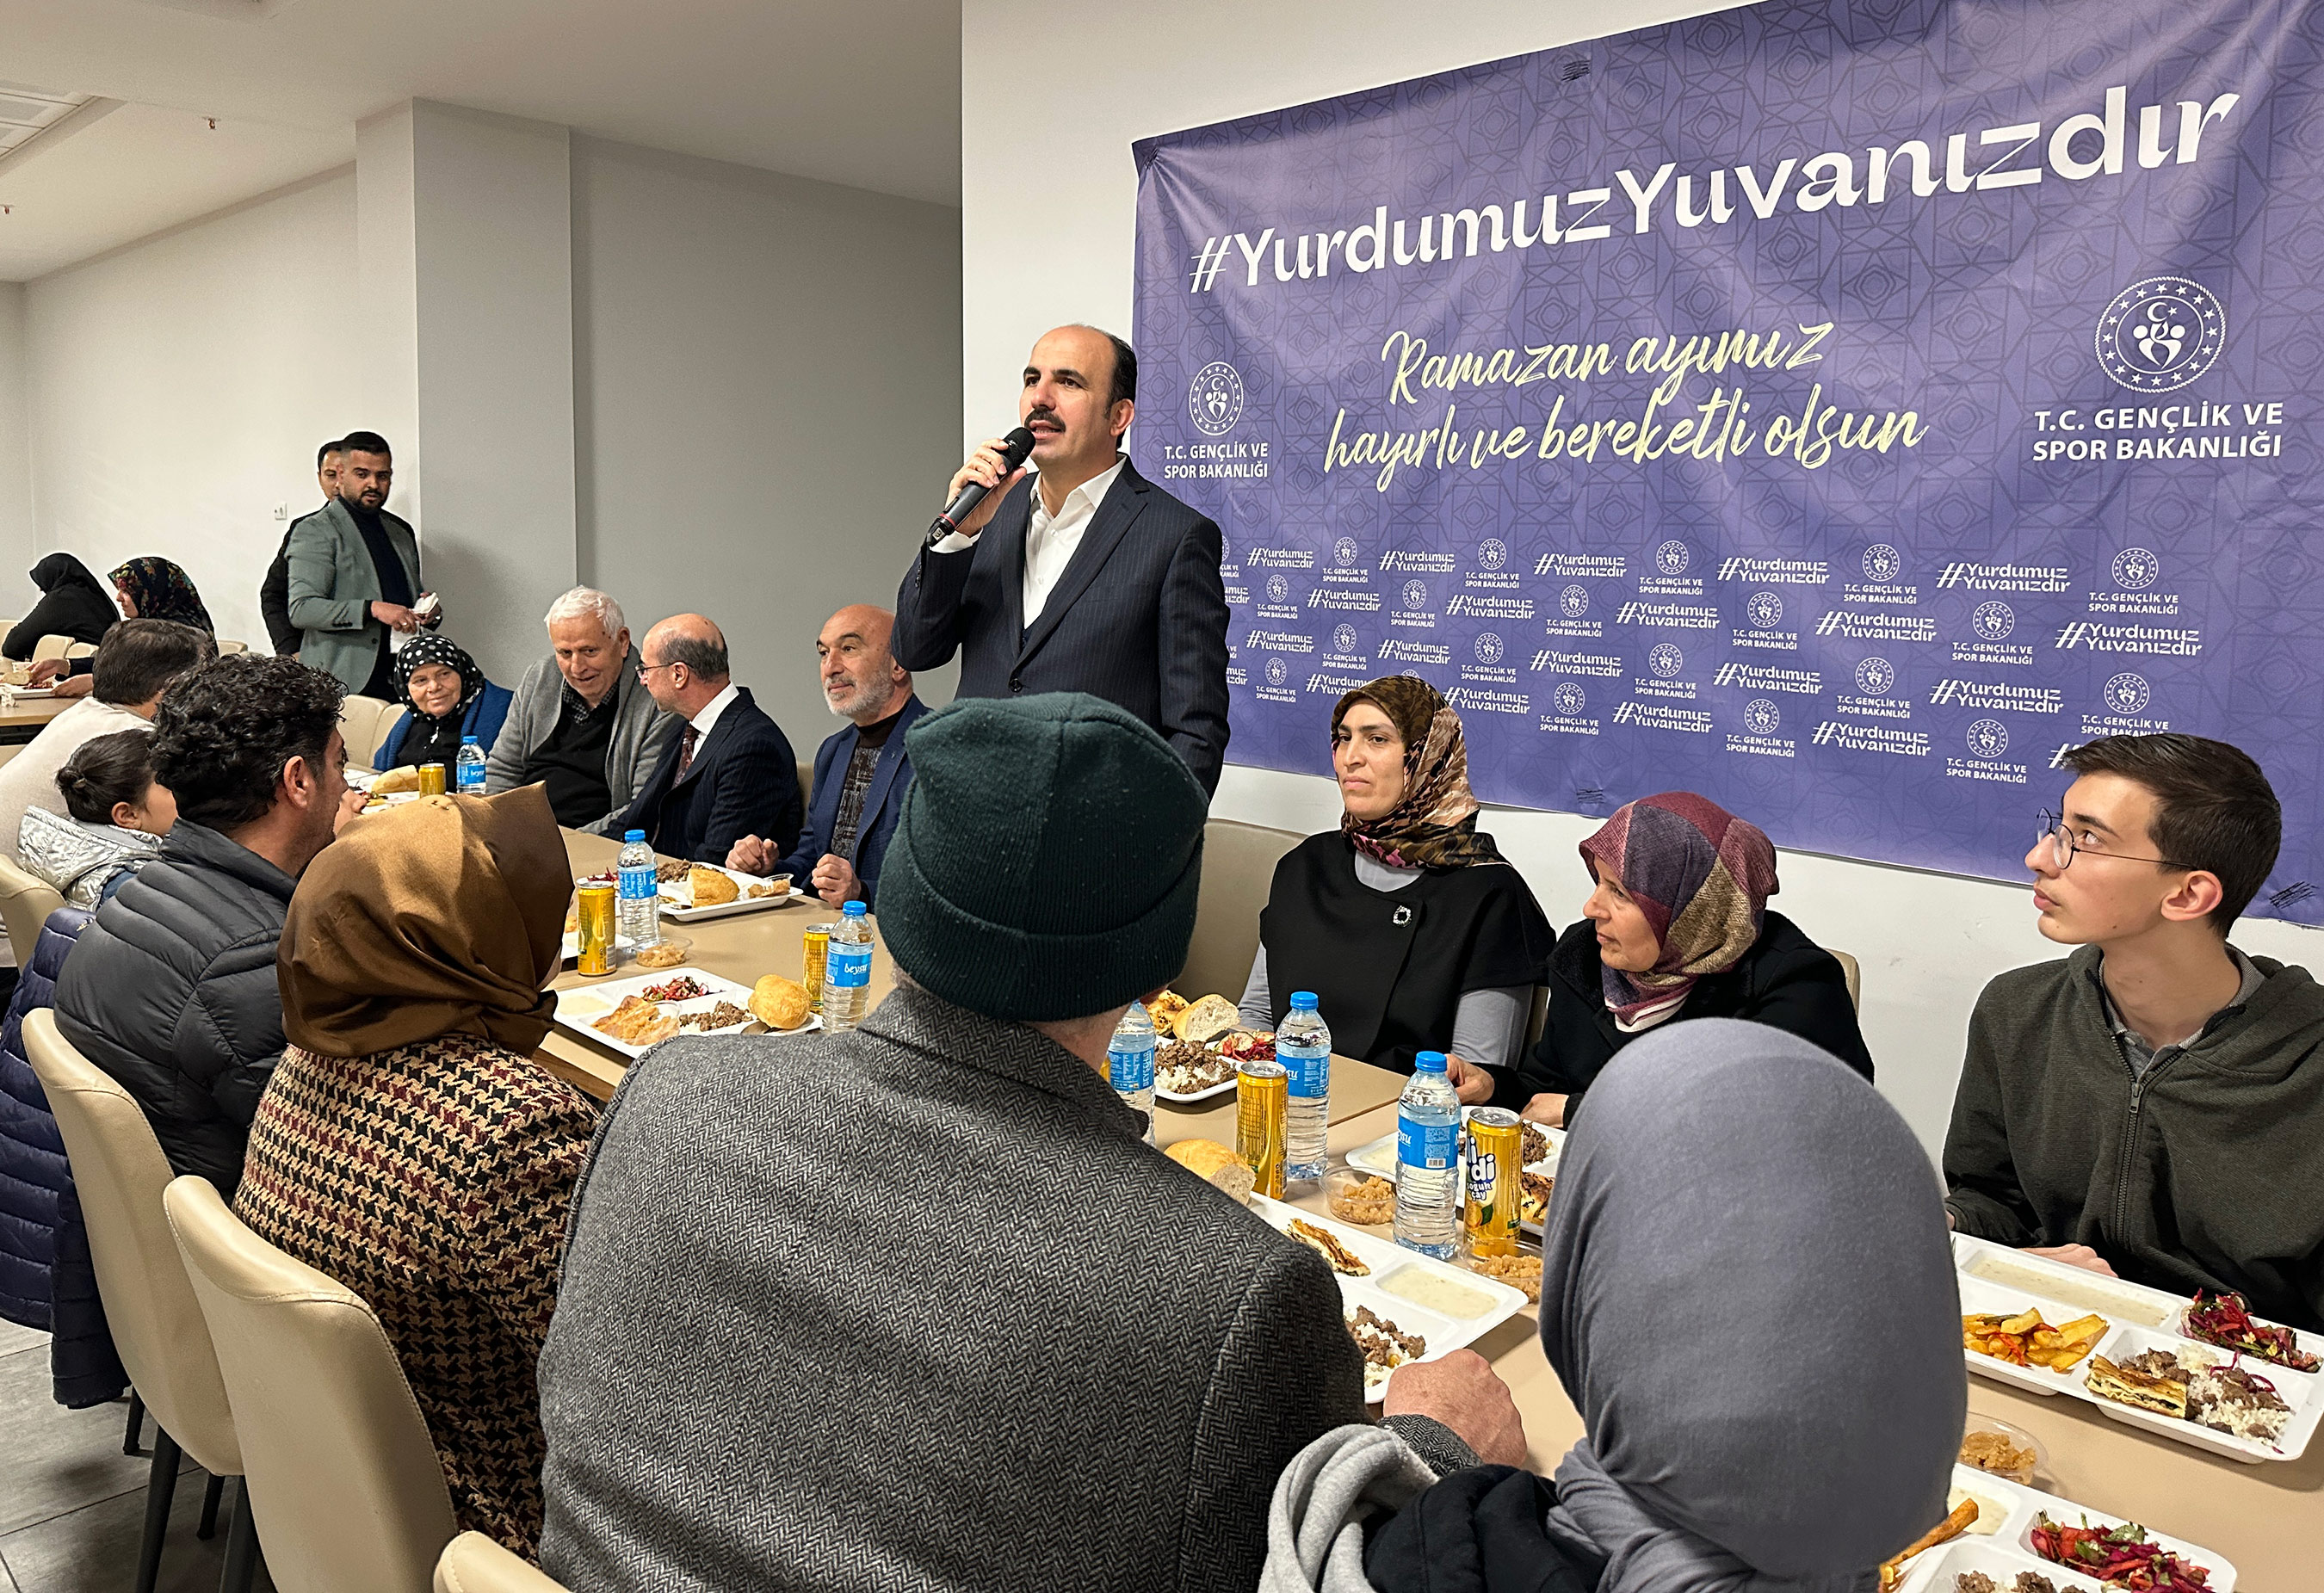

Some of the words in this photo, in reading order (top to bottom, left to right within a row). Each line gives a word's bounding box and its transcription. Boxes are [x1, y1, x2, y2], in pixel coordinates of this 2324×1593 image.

[1189, 85, 2241, 293] #YurdumuzYuvanızdır
[1381, 330, 1619, 405] Ramazan
[1625, 322, 1834, 405] ayımız
[2035, 410, 2085, 431] T.C.
[2094, 400, 2232, 434] GENÇLİK
[2242, 403, 2284, 425] VE
[1324, 404, 1467, 492] hayırlı
[1470, 426, 1533, 469] ve
[1538, 386, 1756, 464] bereketli
[1765, 383, 1930, 469] olsun
[1164, 446, 1187, 460] T.C.
[1190, 441, 1247, 462] GENÇLİK
[1251, 442, 1268, 458] VE
[2032, 440, 2107, 461] SPOR
[2116, 430, 2281, 460] BAKANLIĞI
[1164, 465, 1196, 479] SPOR
[1199, 460, 1268, 478] BAKANLIĞI
[1247, 547, 1313, 565] #Yurdumuz
[1260, 557, 1314, 568] Yuvanızdır
[1379, 550, 1454, 570] #Yurdumuz
[1395, 560, 1456, 571] Yuvanızdır
[1534, 553, 1624, 574] #Yurdumuz
[1717, 557, 1826, 580] #Yurdumuz
[1478, 571, 1507, 580] GENÇLİK
[1554, 565, 1627, 577] Yuvanızdır
[1739, 570, 1830, 583] Yuvanızdır
[1937, 563, 2067, 587] #Yurdumuz
[1655, 577, 1690, 586] GENÇLİK
[1964, 577, 2071, 591] Yuvanızdır
[1660, 586, 1702, 595] BAKANLIĞI
[1862, 584, 1901, 594] GENÇLİK
[1307, 589, 1379, 608] #Yurdumuz
[1844, 593, 1866, 602] SPOR
[1868, 595, 1916, 604] BAKANLIĞI
[2089, 592, 2108, 601] T.C.
[2111, 592, 2160, 603] GENÇLİK
[2163, 594, 2178, 602] VE
[1322, 599, 1381, 610] Yuvanızdır
[1446, 595, 1532, 615] #Yurdumuz
[2088, 602, 2116, 612] SPOR
[2119, 604, 2178, 614] BAKANLIĞI
[1463, 606, 1535, 619] Yuvanızdır
[1616, 602, 1716, 624] #Yurdumuz
[1560, 620, 1590, 628] GENÇLİK
[1636, 615, 1720, 628] Yuvanızdır
[1815, 611, 1934, 634] #Yurdumuz
[1246, 630, 1312, 648] #Yurdumuz
[1564, 628, 1601, 637] BAKANLIĞI
[1733, 628, 1746, 637] T.C.
[1748, 630, 1783, 639] GENÇLİK
[1842, 626, 1937, 640] Yuvanızdır
[2055, 622, 2198, 648] #Yurdumuz
[1260, 640, 1314, 652] Yuvanızdır
[1377, 639, 1449, 658] #Yurdumuz
[1732, 638, 1752, 646] SPOR
[1753, 639, 1796, 650] BAKANLIĞI
[1952, 641, 1969, 651] T.C.
[1972, 643, 2016, 653] GENÇLİK
[2019, 645, 2032, 654] VE
[2086, 639, 2202, 655] Yuvanızdır
[1394, 651, 1451, 664] Yuvanızdır
[1530, 650, 1620, 671] #Yurdumuz
[1951, 652, 1977, 661] SPOR
[1979, 654, 2032, 664] BAKANLIĞI
[1474, 665, 1505, 674] GENÇLİK
[1548, 664, 1623, 676] Yuvanızdır
[1714, 663, 1820, 685] #Yurdumuz
[1480, 674, 1516, 682] BAKANLIĞI
[1649, 679, 1683, 688] GENÇLİK
[1737, 676, 1823, 694] Yuvanızdır
[1930, 679, 2060, 703] #Yurdumuz
[1443, 687, 1529, 706] #Yurdumuz
[1654, 688, 1695, 698] BAKANLIĞI
[1459, 701, 1530, 713] Yuvanızdır
[1837, 695, 1853, 704] T.C.
[1855, 697, 1895, 707] GENÇLİK
[1897, 700, 1910, 708] VE
[1958, 695, 2063, 713] Yuvanızdır
[1613, 701, 1710, 723] #Yurdumuz
[1837, 705, 1859, 713] SPOR
[1862, 707, 1910, 718] BAKANLIĞI
[1554, 716, 1586, 725] GENÇLİK
[1634, 715, 1713, 732] Yuvanızdır
[2081, 714, 2100, 724] T.C.
[2104, 716, 2151, 728] GENÇLİK
[2154, 720, 2168, 730] VE
[1560, 725, 1598, 735] BAKANLIĞI
[1812, 721, 1927, 744] #Yurdumuz
[2081, 725, 2108, 735] SPOR
[2111, 728, 2165, 738] BAKAN
[1743, 736, 1781, 746] GENÇLİK
[1783, 739, 1795, 748] VE
[1837, 737, 1931, 756] Yuvanızdır
[1726, 743, 1747, 752] SPOR
[1749, 745, 1794, 756] BAKANLIĞI
[1946, 757, 1964, 767] T.C.
[1966, 760, 2010, 771] GENÇLİK
[2012, 764, 2026, 773] VE
[1946, 768, 1971, 777] SPOR
[1973, 770, 2025, 783] BAKANLIĞI
[844, 962, 868, 975] beysu
[1471, 1154, 1495, 1181] di
[1471, 1190, 1486, 1201] çay
